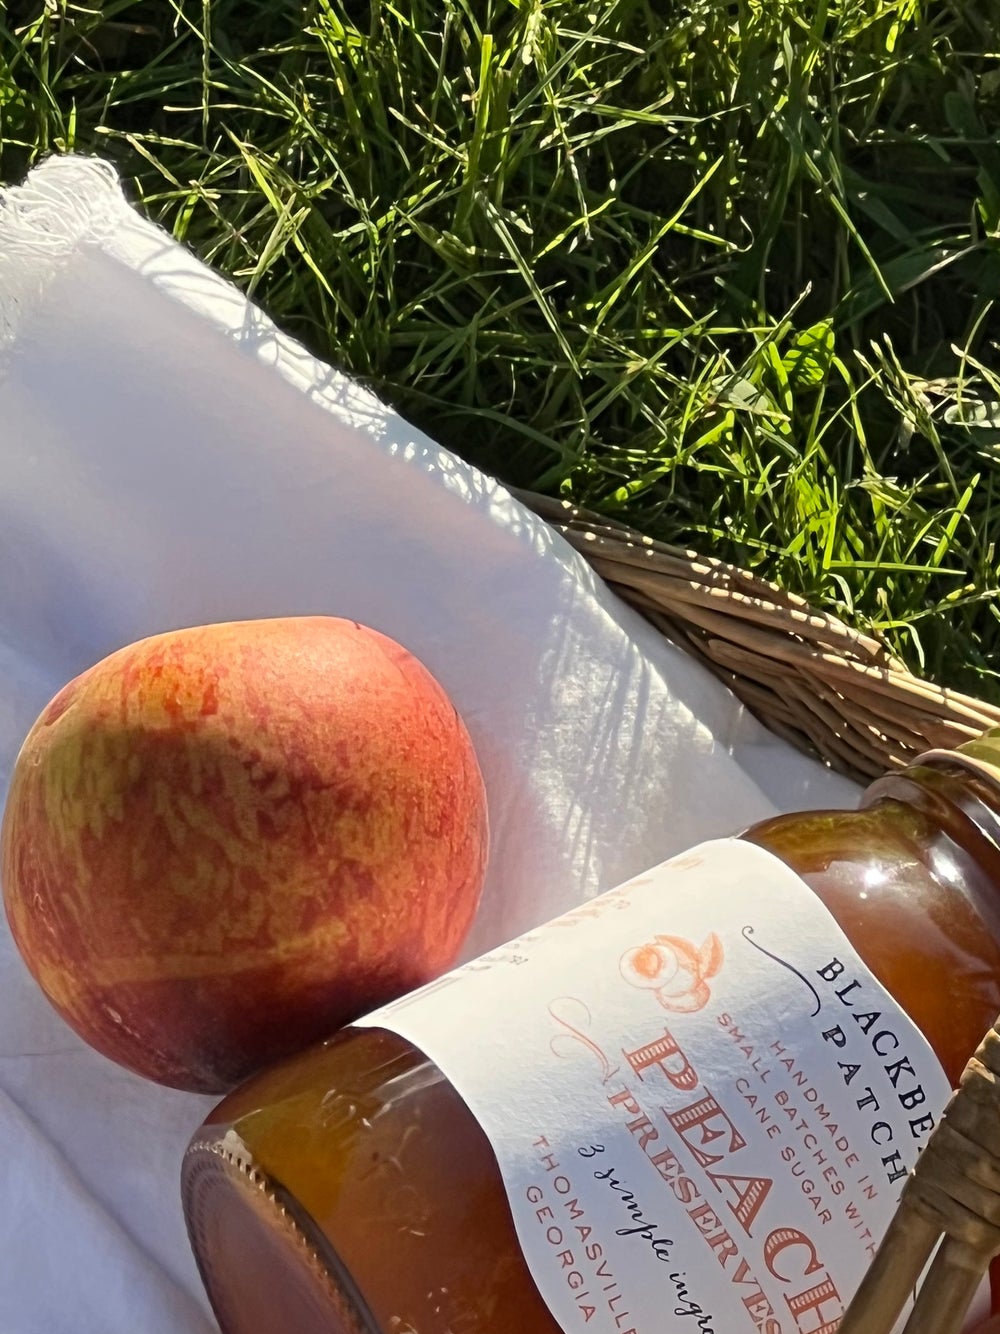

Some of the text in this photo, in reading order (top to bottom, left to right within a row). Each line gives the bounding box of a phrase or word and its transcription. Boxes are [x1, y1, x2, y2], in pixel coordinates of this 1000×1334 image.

[717, 1013, 771, 1084] SMALL
[774, 1090, 845, 1196] BATCHES
[770, 1040, 878, 1200] HANDMADE IN
[816, 957, 937, 1153] BLACKBE
[821, 1024, 908, 1185] PATCH
[577, 1144, 606, 1158] 3
[594, 1167, 674, 1262] simple
[735, 1077, 832, 1226] CANE SUGAR
[526, 1185, 597, 1323] GEORGIA
